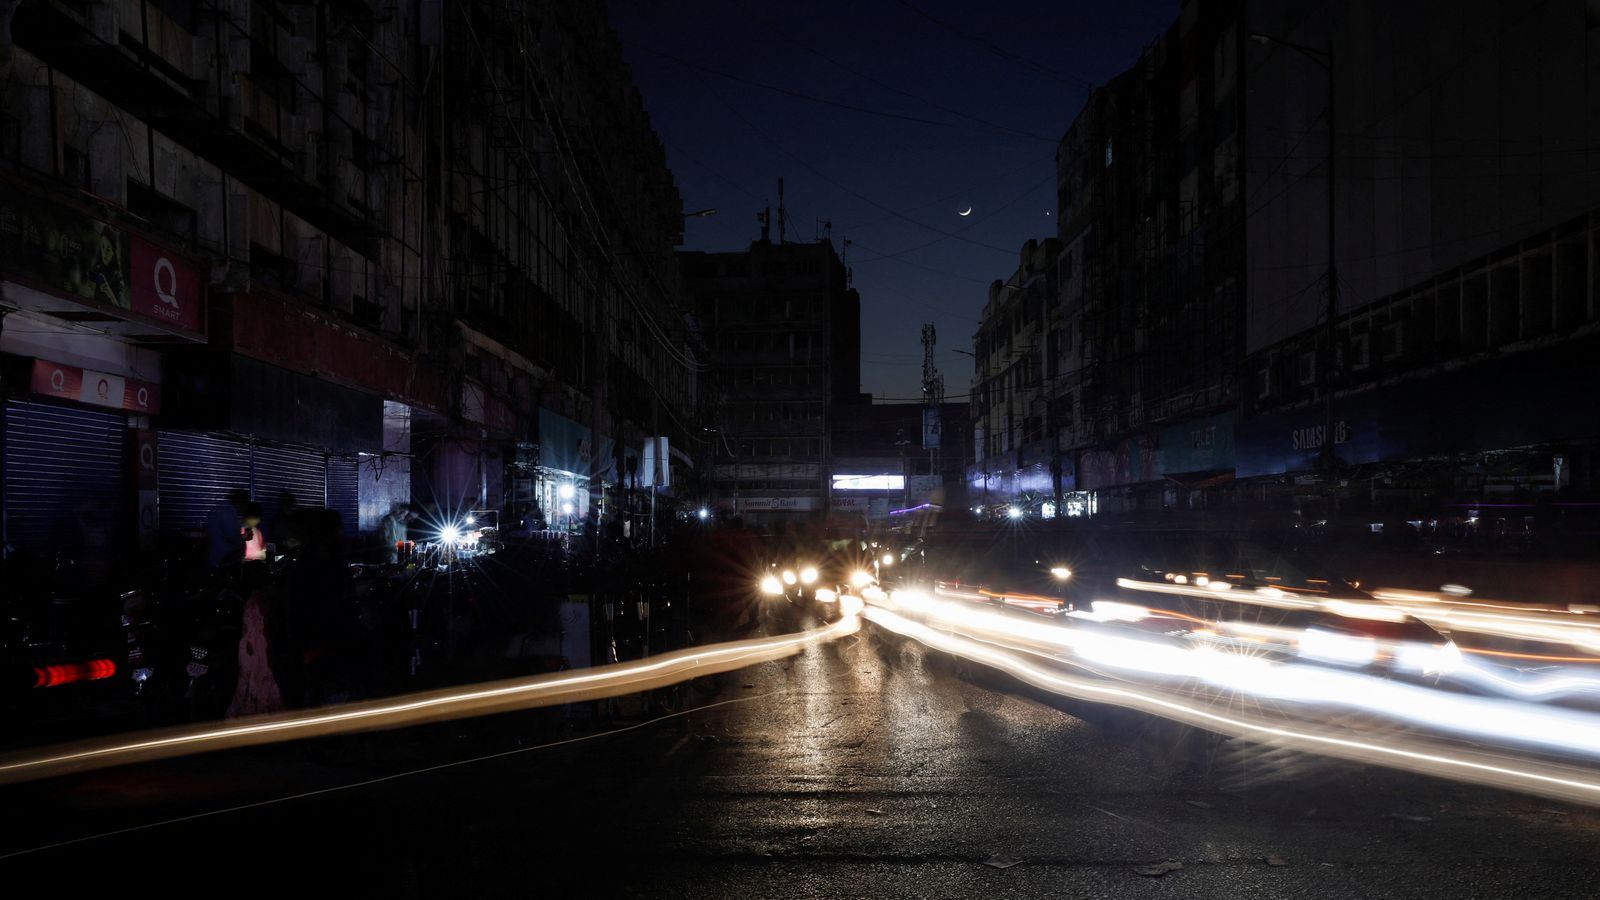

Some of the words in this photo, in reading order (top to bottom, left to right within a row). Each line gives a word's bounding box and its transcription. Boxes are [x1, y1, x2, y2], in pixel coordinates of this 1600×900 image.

[153, 257, 179, 309] Q
[153, 304, 180, 320] SMART
[51, 369, 64, 392] Q
[138, 387, 149, 408] Q
[1292, 420, 1346, 450] SAMSG
